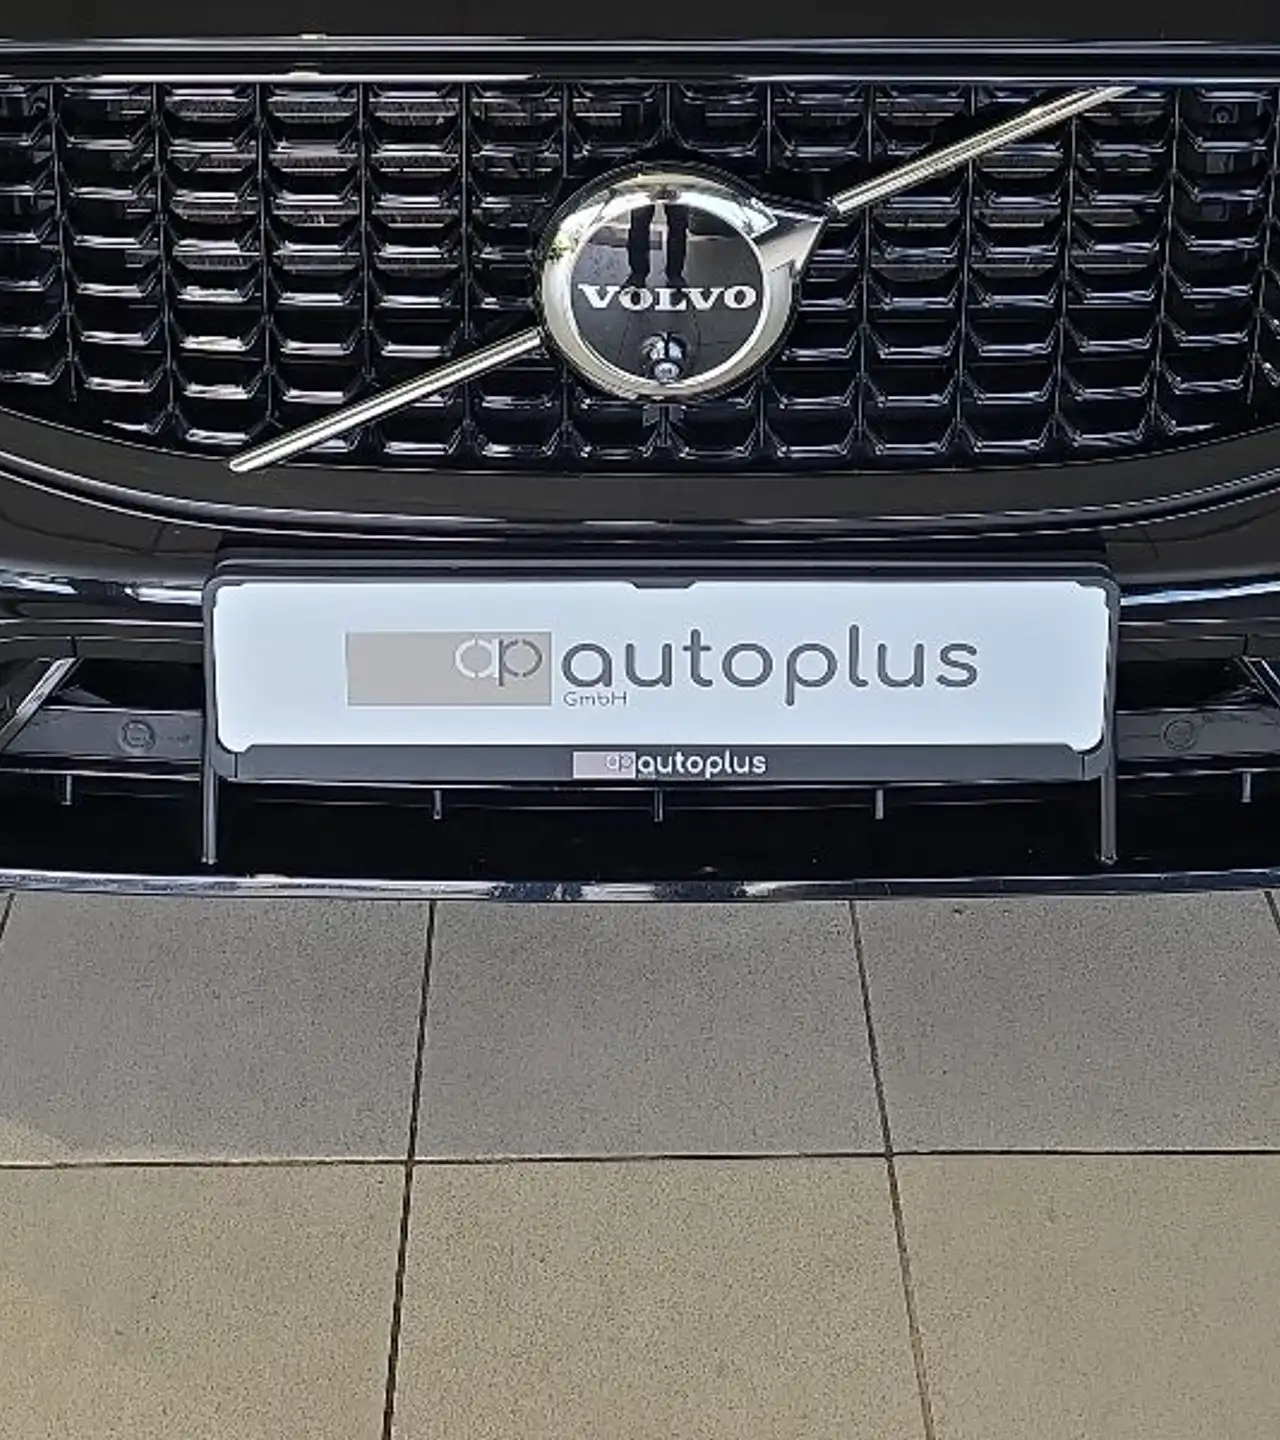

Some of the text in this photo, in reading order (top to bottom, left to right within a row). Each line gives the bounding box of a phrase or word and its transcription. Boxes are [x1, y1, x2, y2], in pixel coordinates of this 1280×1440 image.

[577, 283, 757, 311] VOLVO
[561, 623, 979, 707] autoplus
[563, 691, 628, 707] GmbH
[637, 749, 767, 779] autoplus
